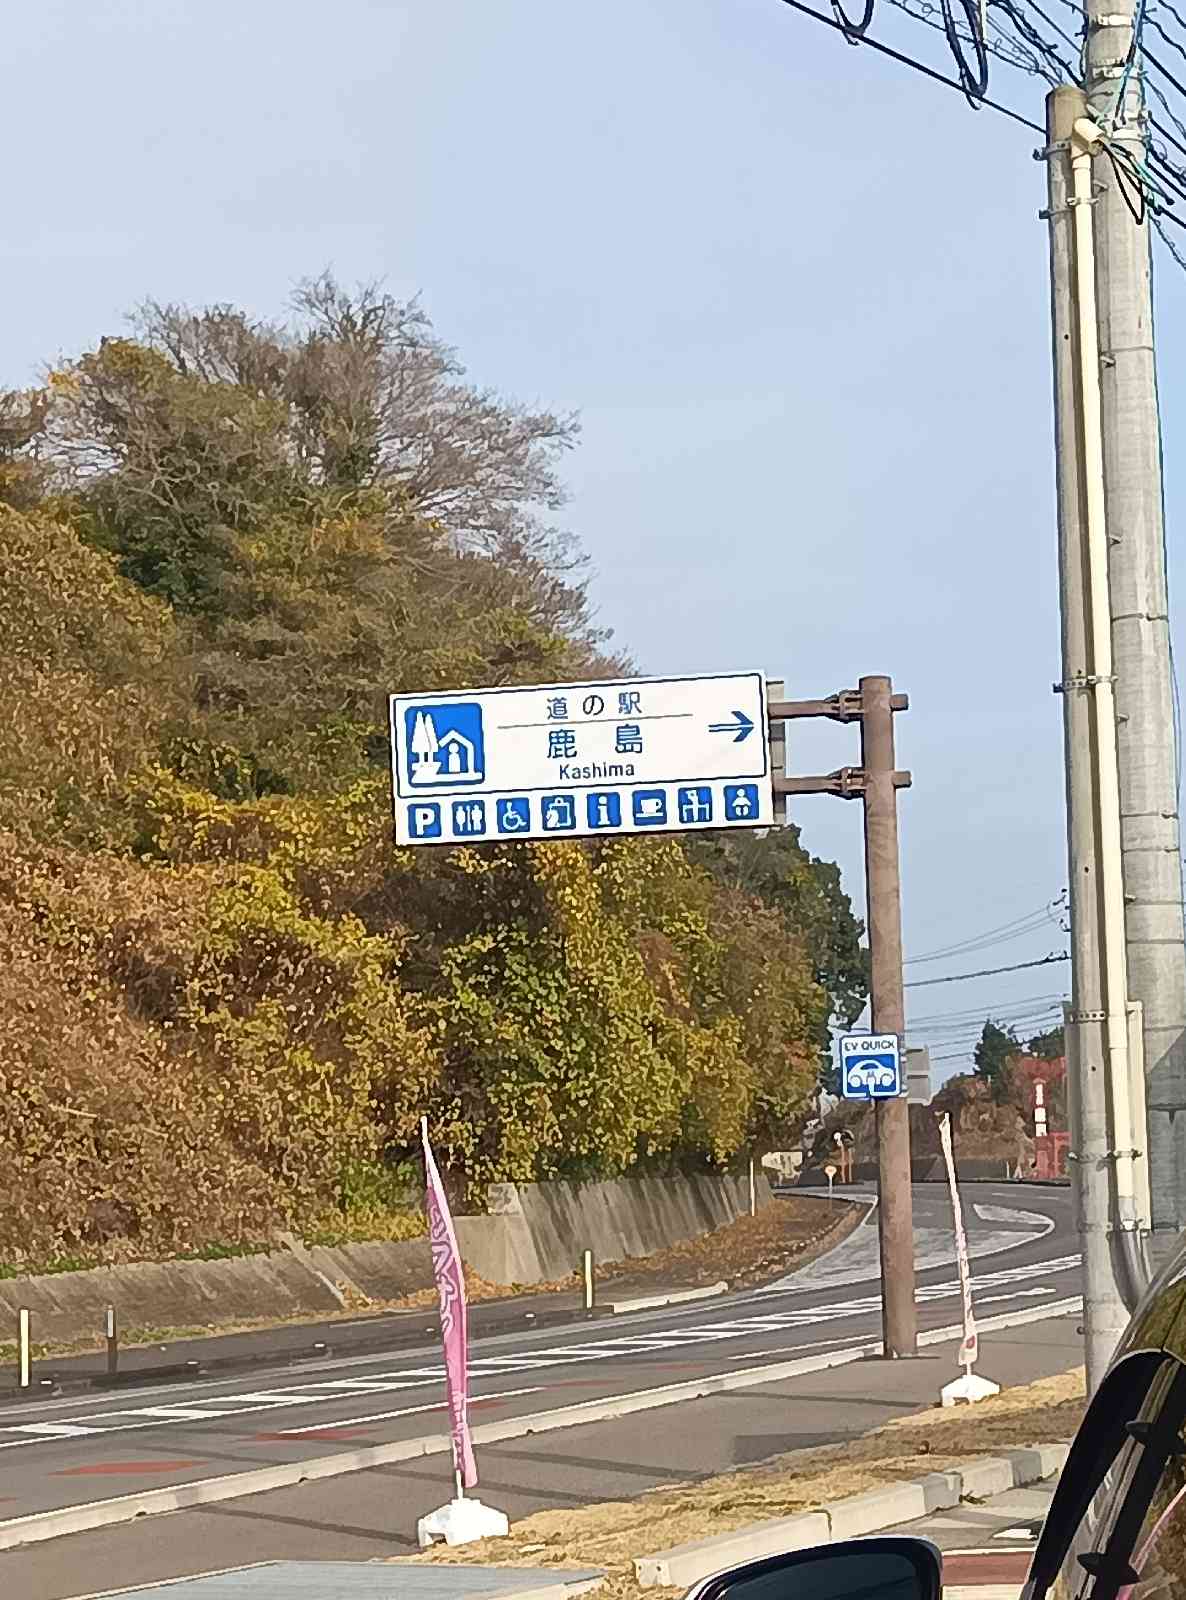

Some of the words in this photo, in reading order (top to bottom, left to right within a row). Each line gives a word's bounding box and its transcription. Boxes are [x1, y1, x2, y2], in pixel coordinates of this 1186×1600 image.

[546, 692, 642, 720] 道の駅
[547, 723, 643, 759] 鹿島
[559, 762, 635, 780] Kashima
[415, 808, 434, 836] P
[845, 1042, 858, 1051] EV
[861, 1040, 895, 1051] QUICK
